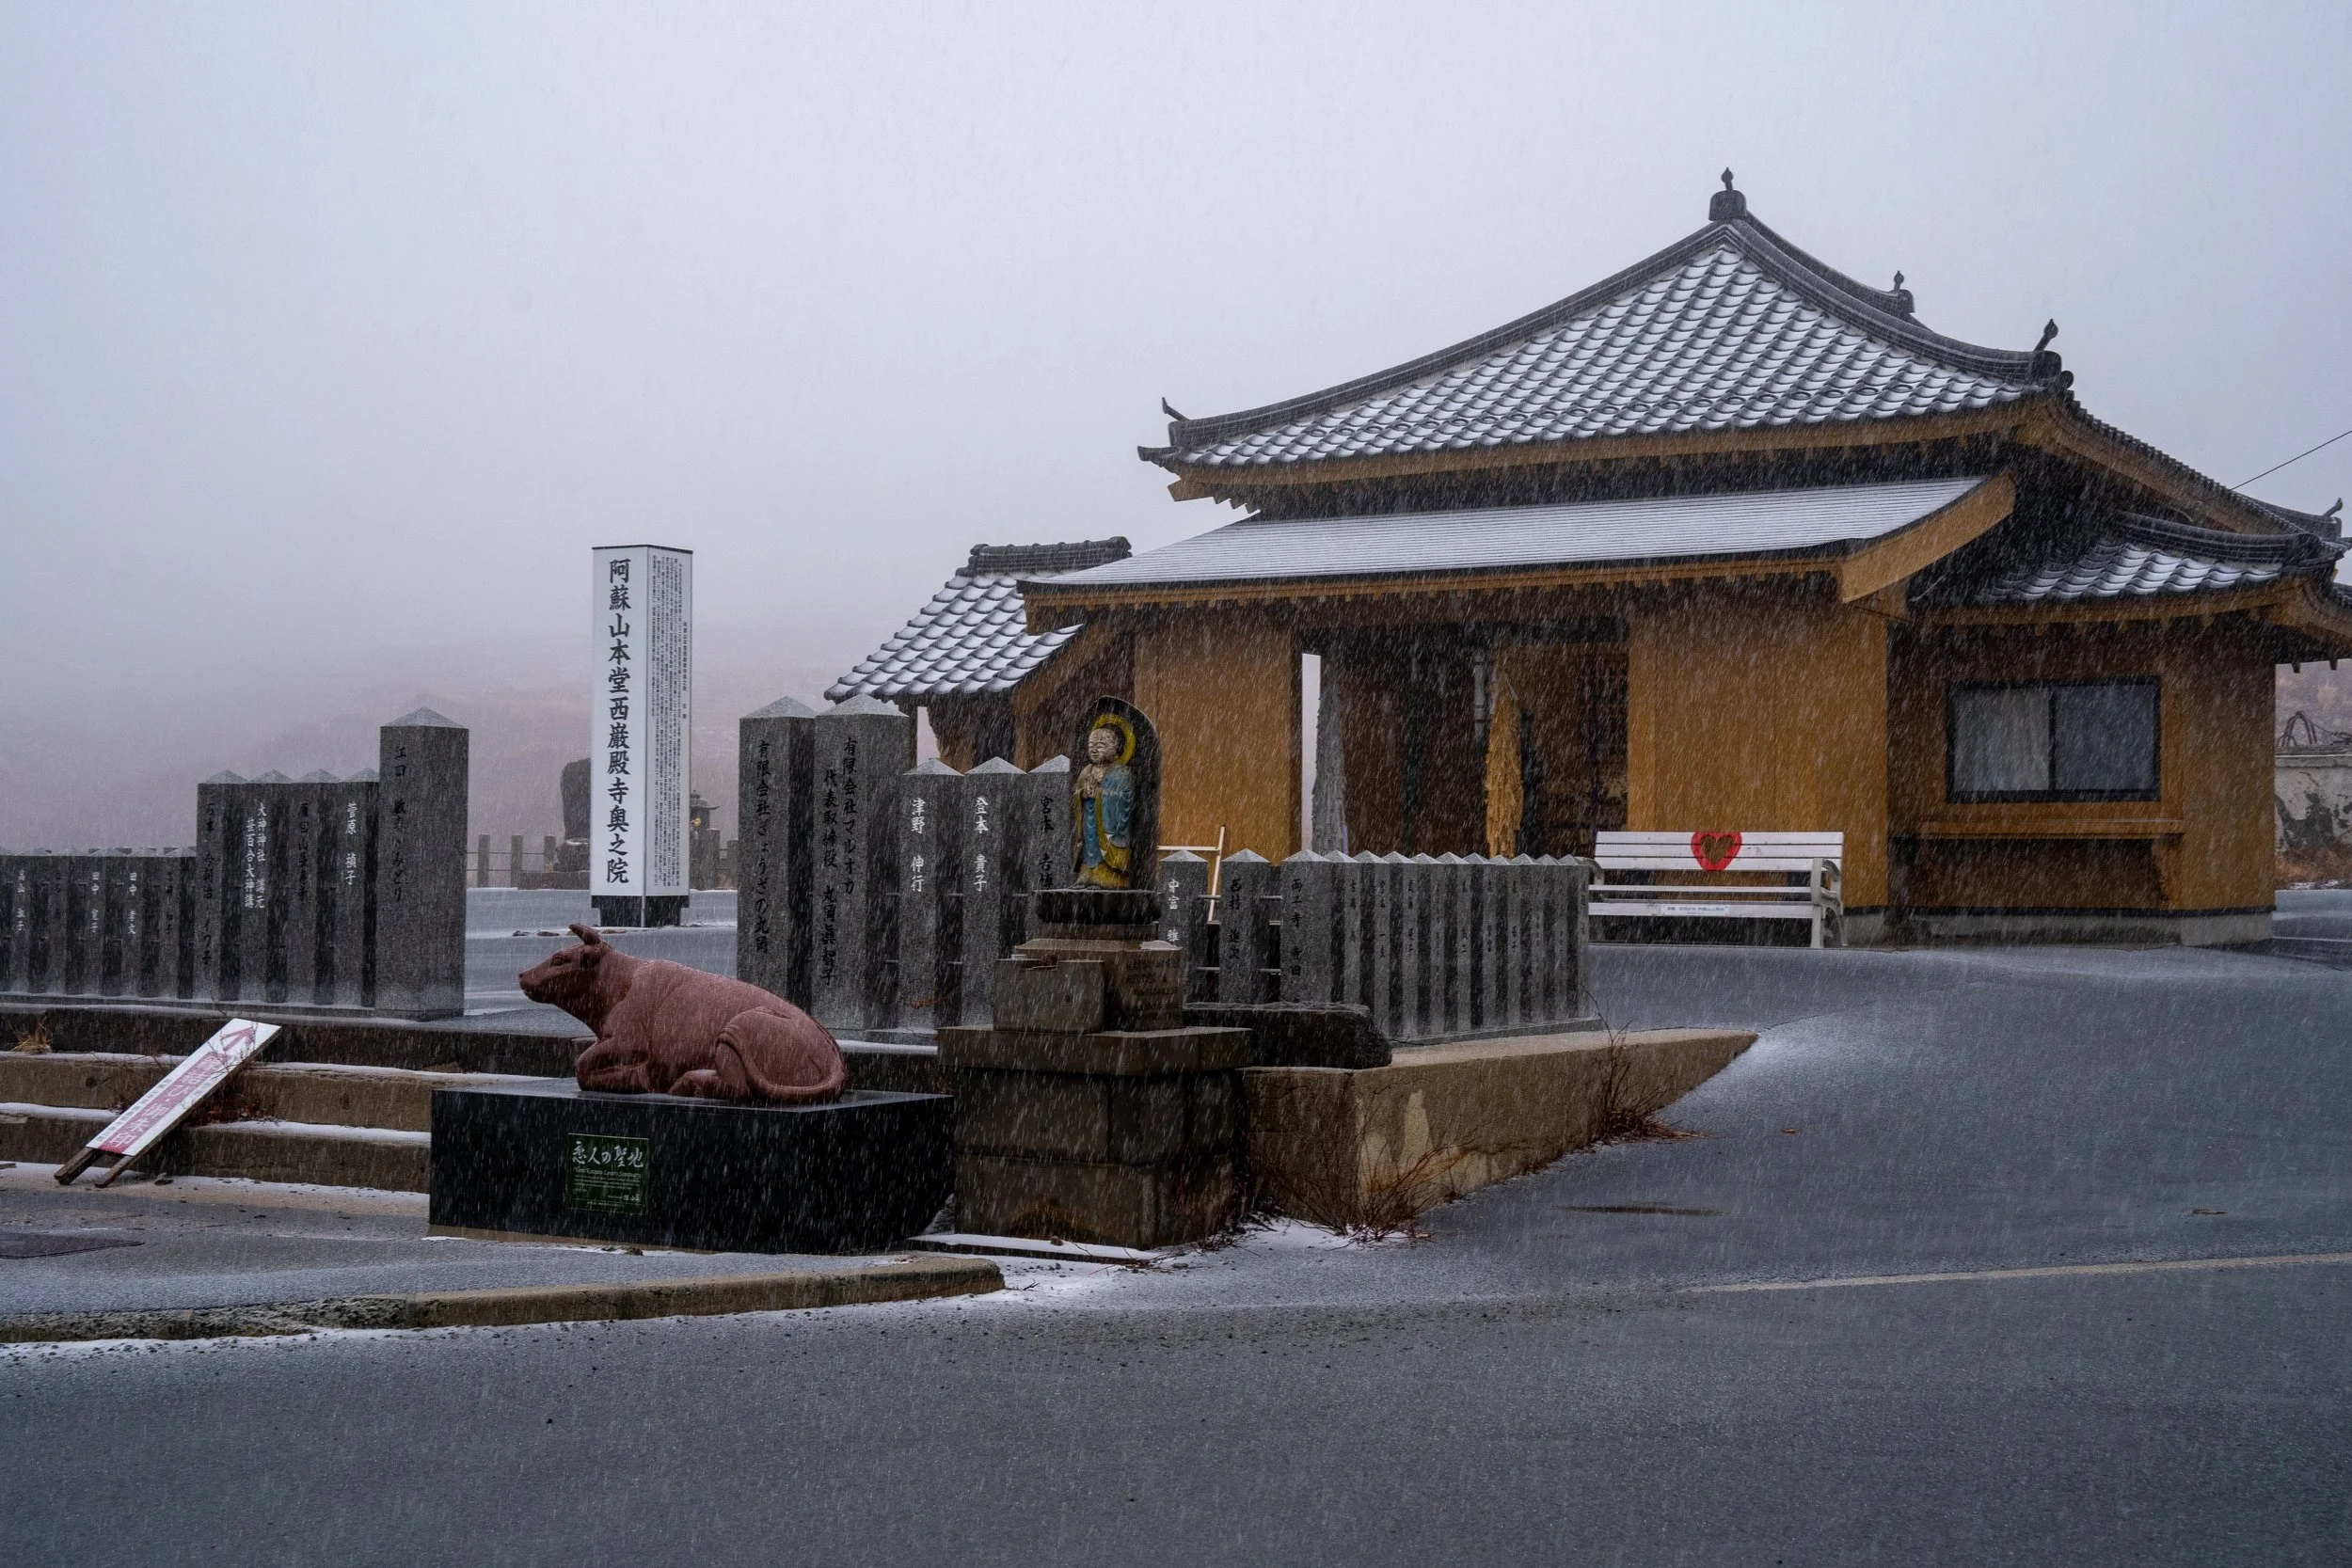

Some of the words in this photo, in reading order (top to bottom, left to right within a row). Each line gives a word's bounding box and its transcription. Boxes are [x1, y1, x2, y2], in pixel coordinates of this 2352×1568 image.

[607, 559, 631, 885] 阿蘇山本堂西巌殿寺奥之院
[911, 798, 927, 834] 津野
